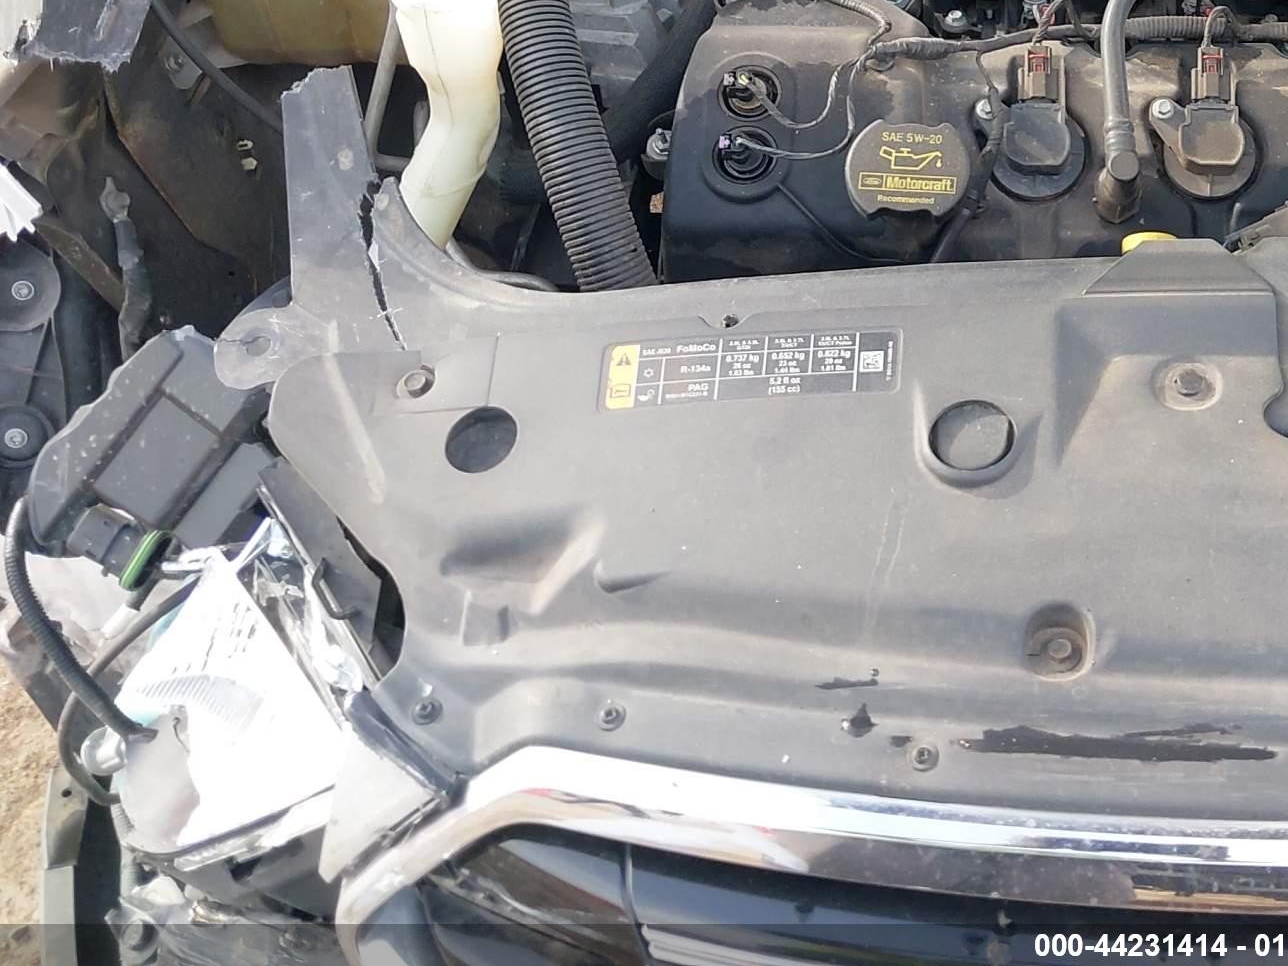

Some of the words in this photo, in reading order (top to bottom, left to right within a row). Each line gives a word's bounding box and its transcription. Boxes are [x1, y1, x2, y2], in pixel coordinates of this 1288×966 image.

[882, 132, 902, 142] SAE
[906, 134, 943, 144] 5W-20
[886, 176, 952, 191] Motorcraft
[877, 194, 934, 204] Recommended
[676, 344, 716, 353] FoMoCo
[680, 364, 711, 373] R-134a
[688, 383, 709, 392] PAG
[768, 386, 786, 395] (155
[787, 385, 800, 393] cc)
